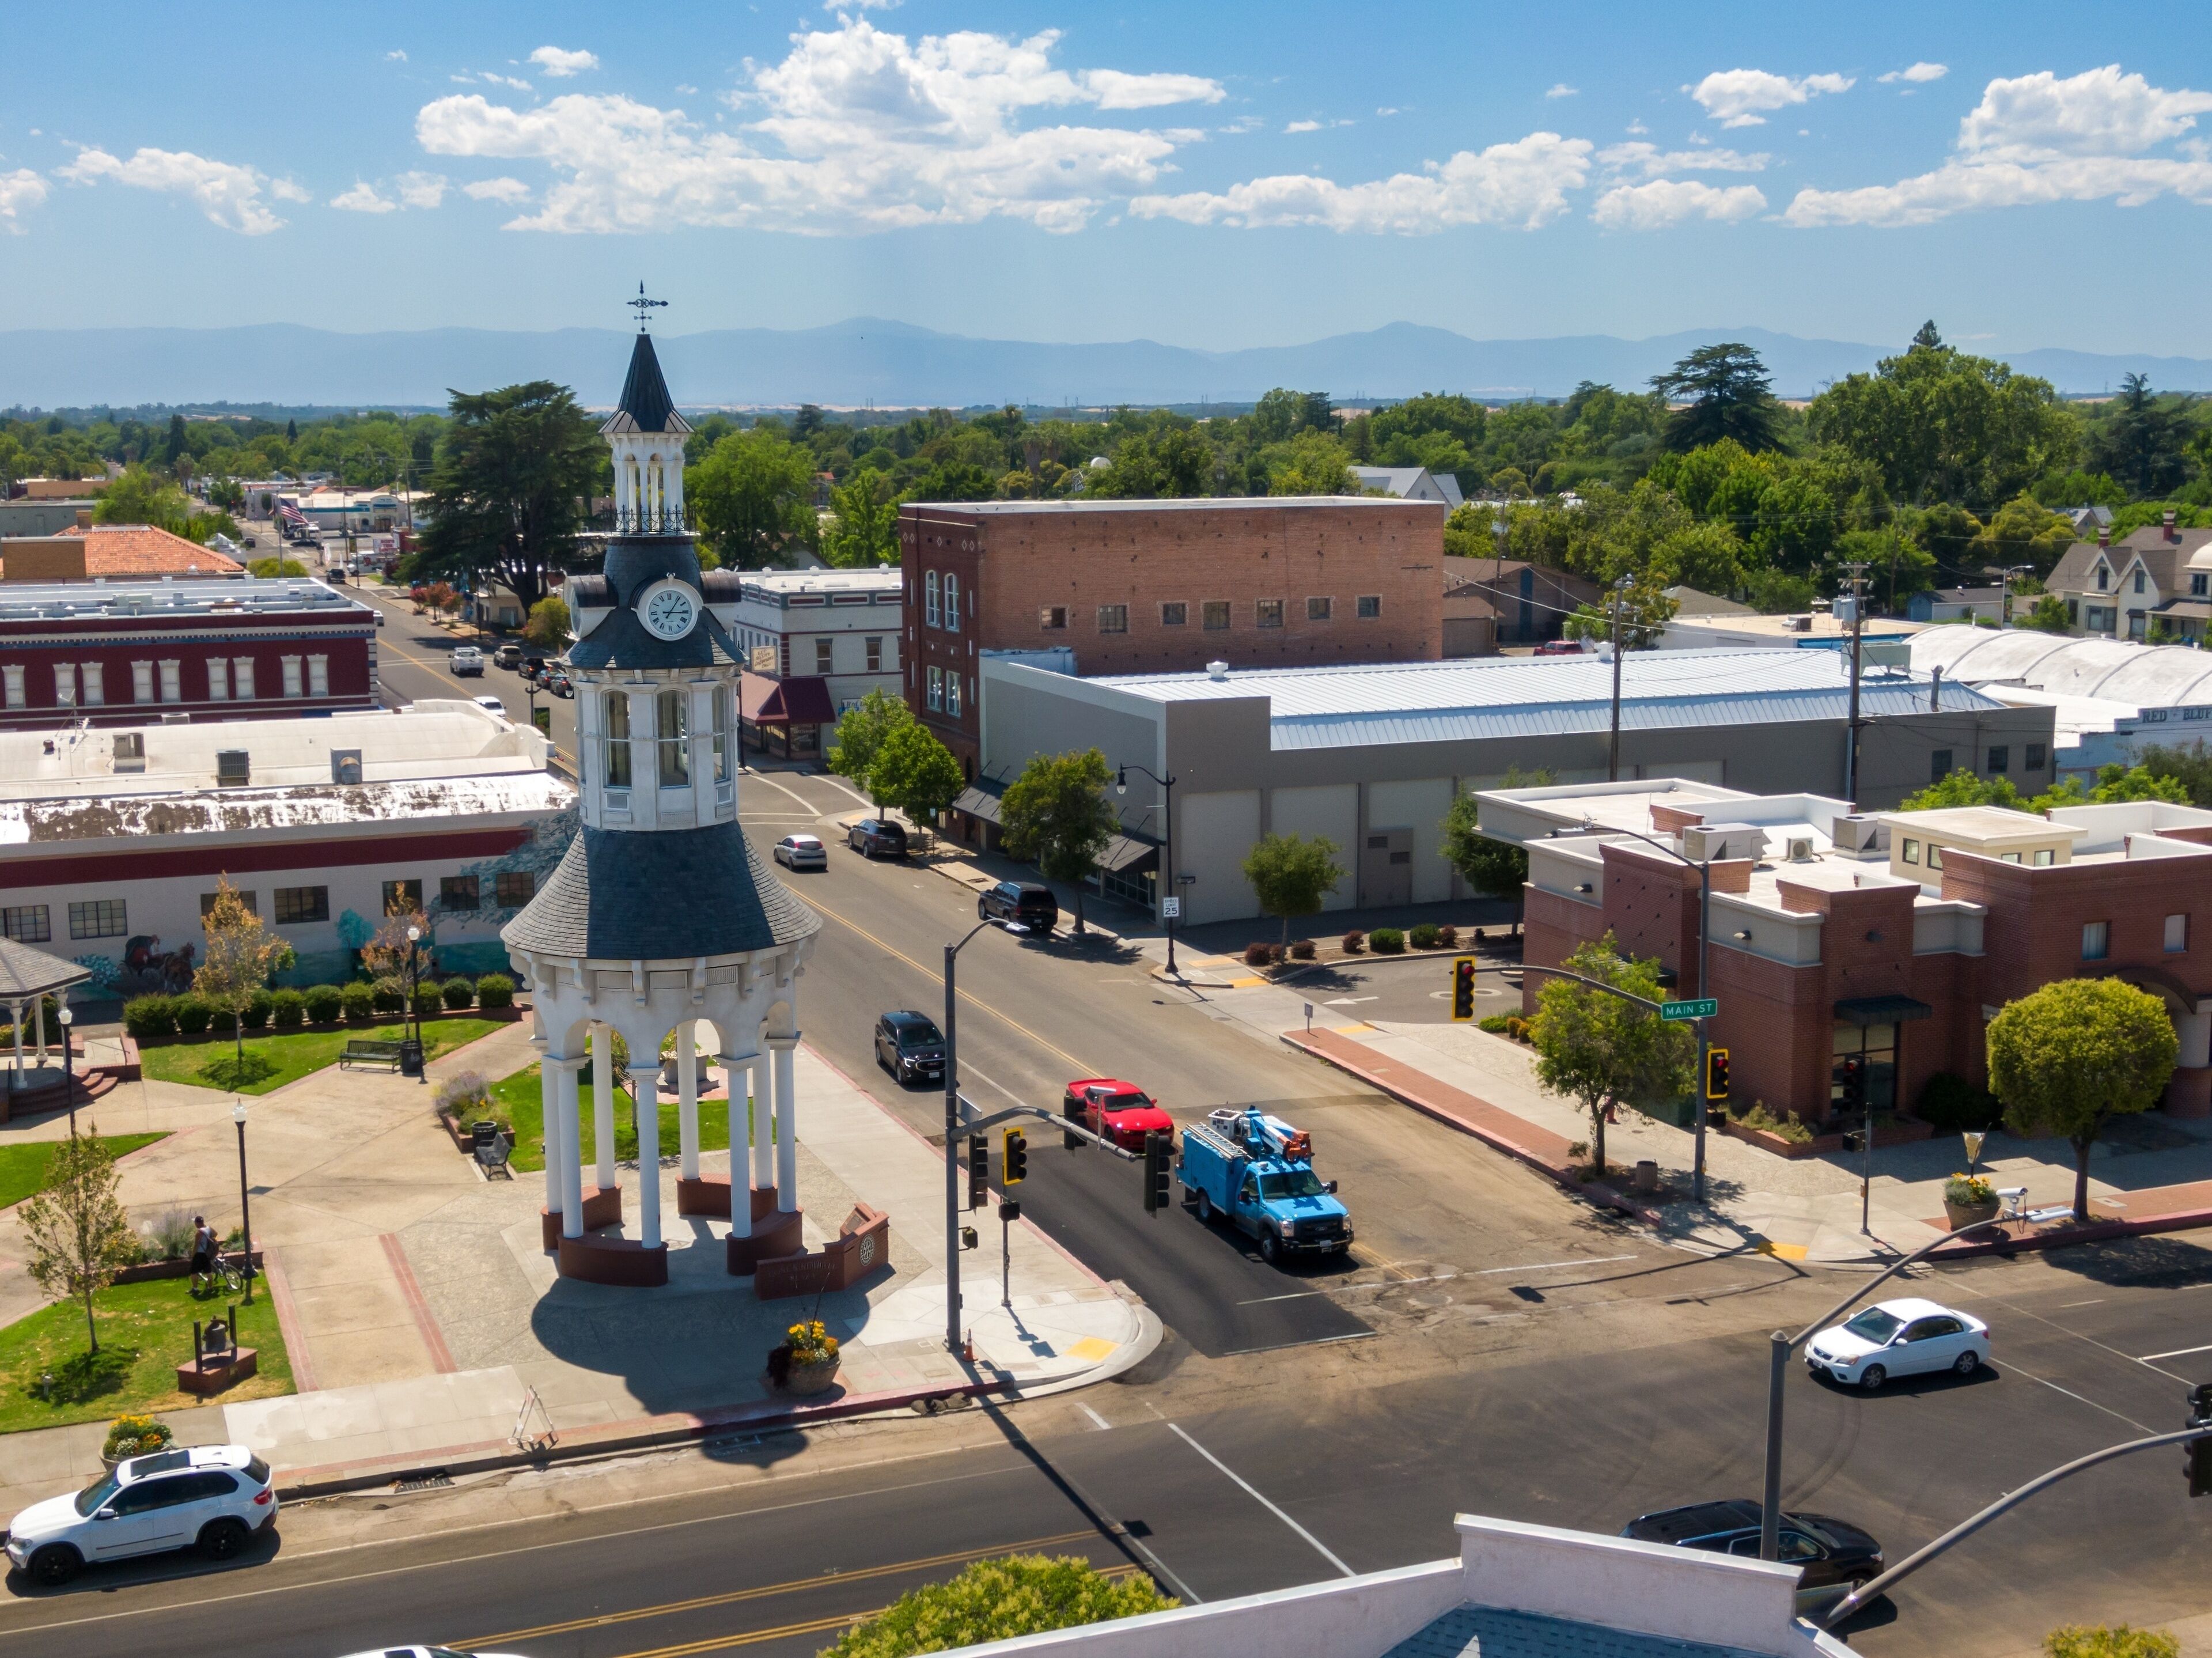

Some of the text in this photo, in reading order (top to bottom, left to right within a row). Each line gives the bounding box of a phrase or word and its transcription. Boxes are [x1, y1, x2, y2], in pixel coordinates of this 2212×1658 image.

[2142, 710, 2166, 723] RED
[1666, 1004, 1712, 1016] MAIN ST
